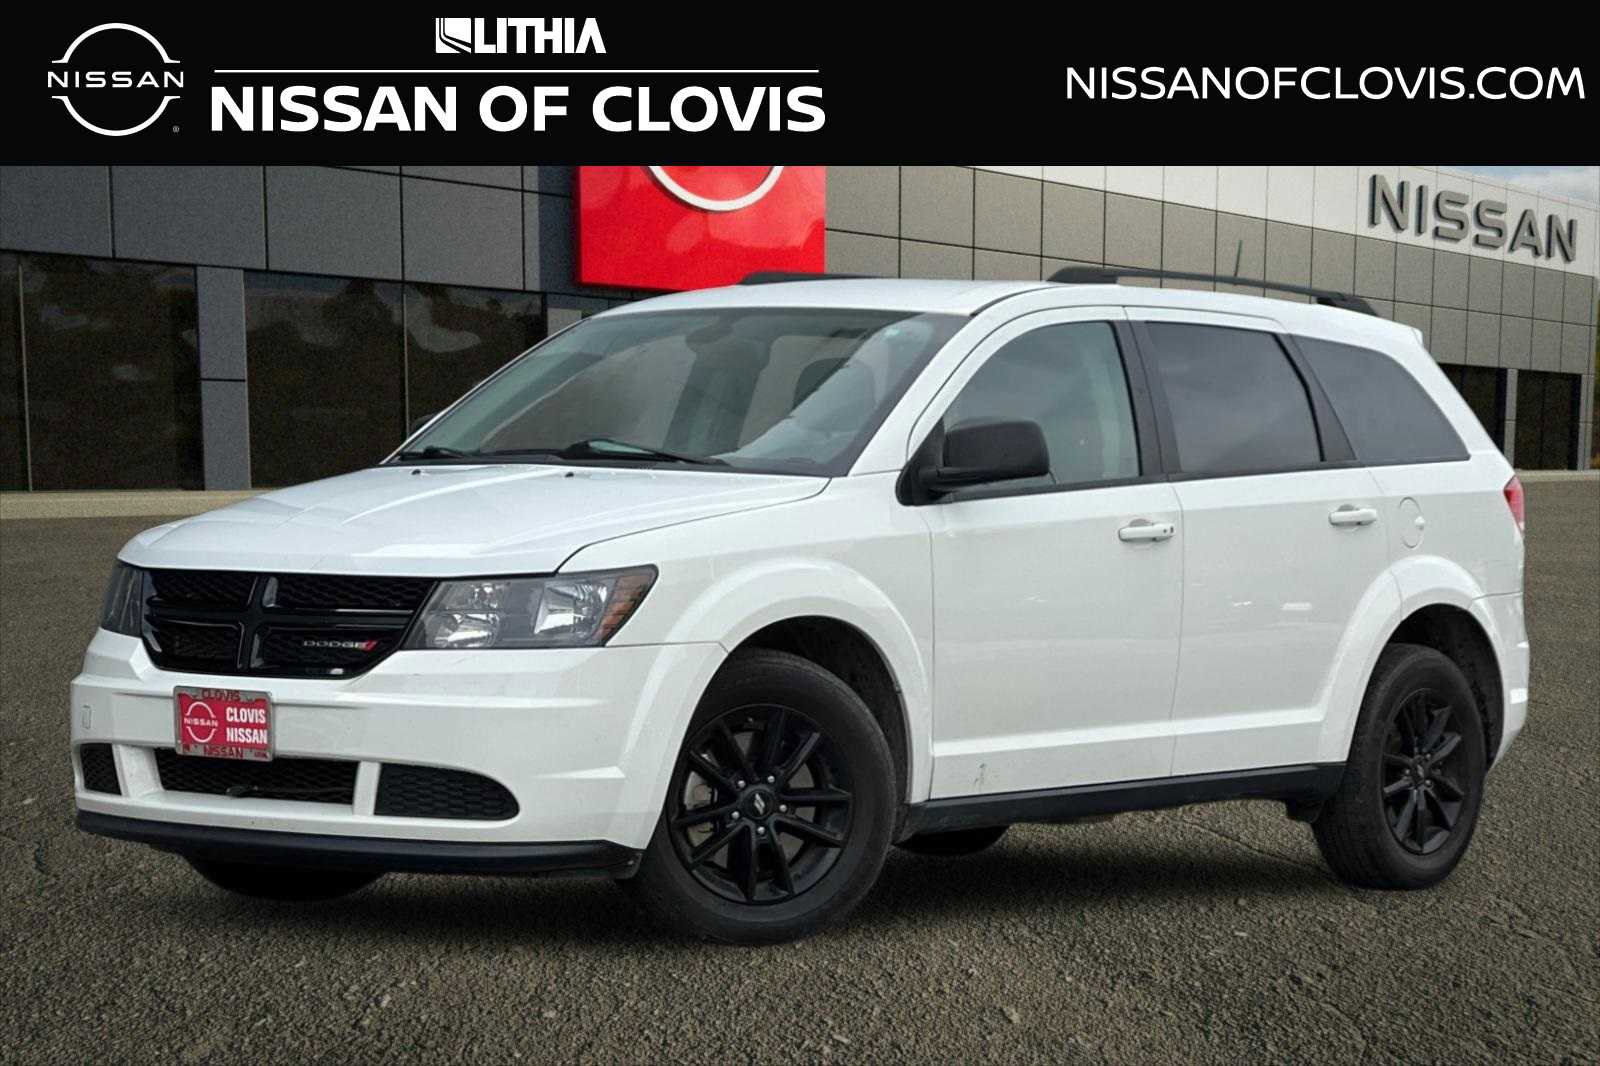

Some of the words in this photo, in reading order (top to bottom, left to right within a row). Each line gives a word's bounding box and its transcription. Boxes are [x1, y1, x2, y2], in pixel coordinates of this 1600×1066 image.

[1368, 173, 1578, 263] NISSAN
[303, 640, 367, 649] DODGE
[183, 717, 218, 727] NISSAN
[225, 706, 266, 724] CLOVIS
[226, 727, 268, 744] NISSAN
